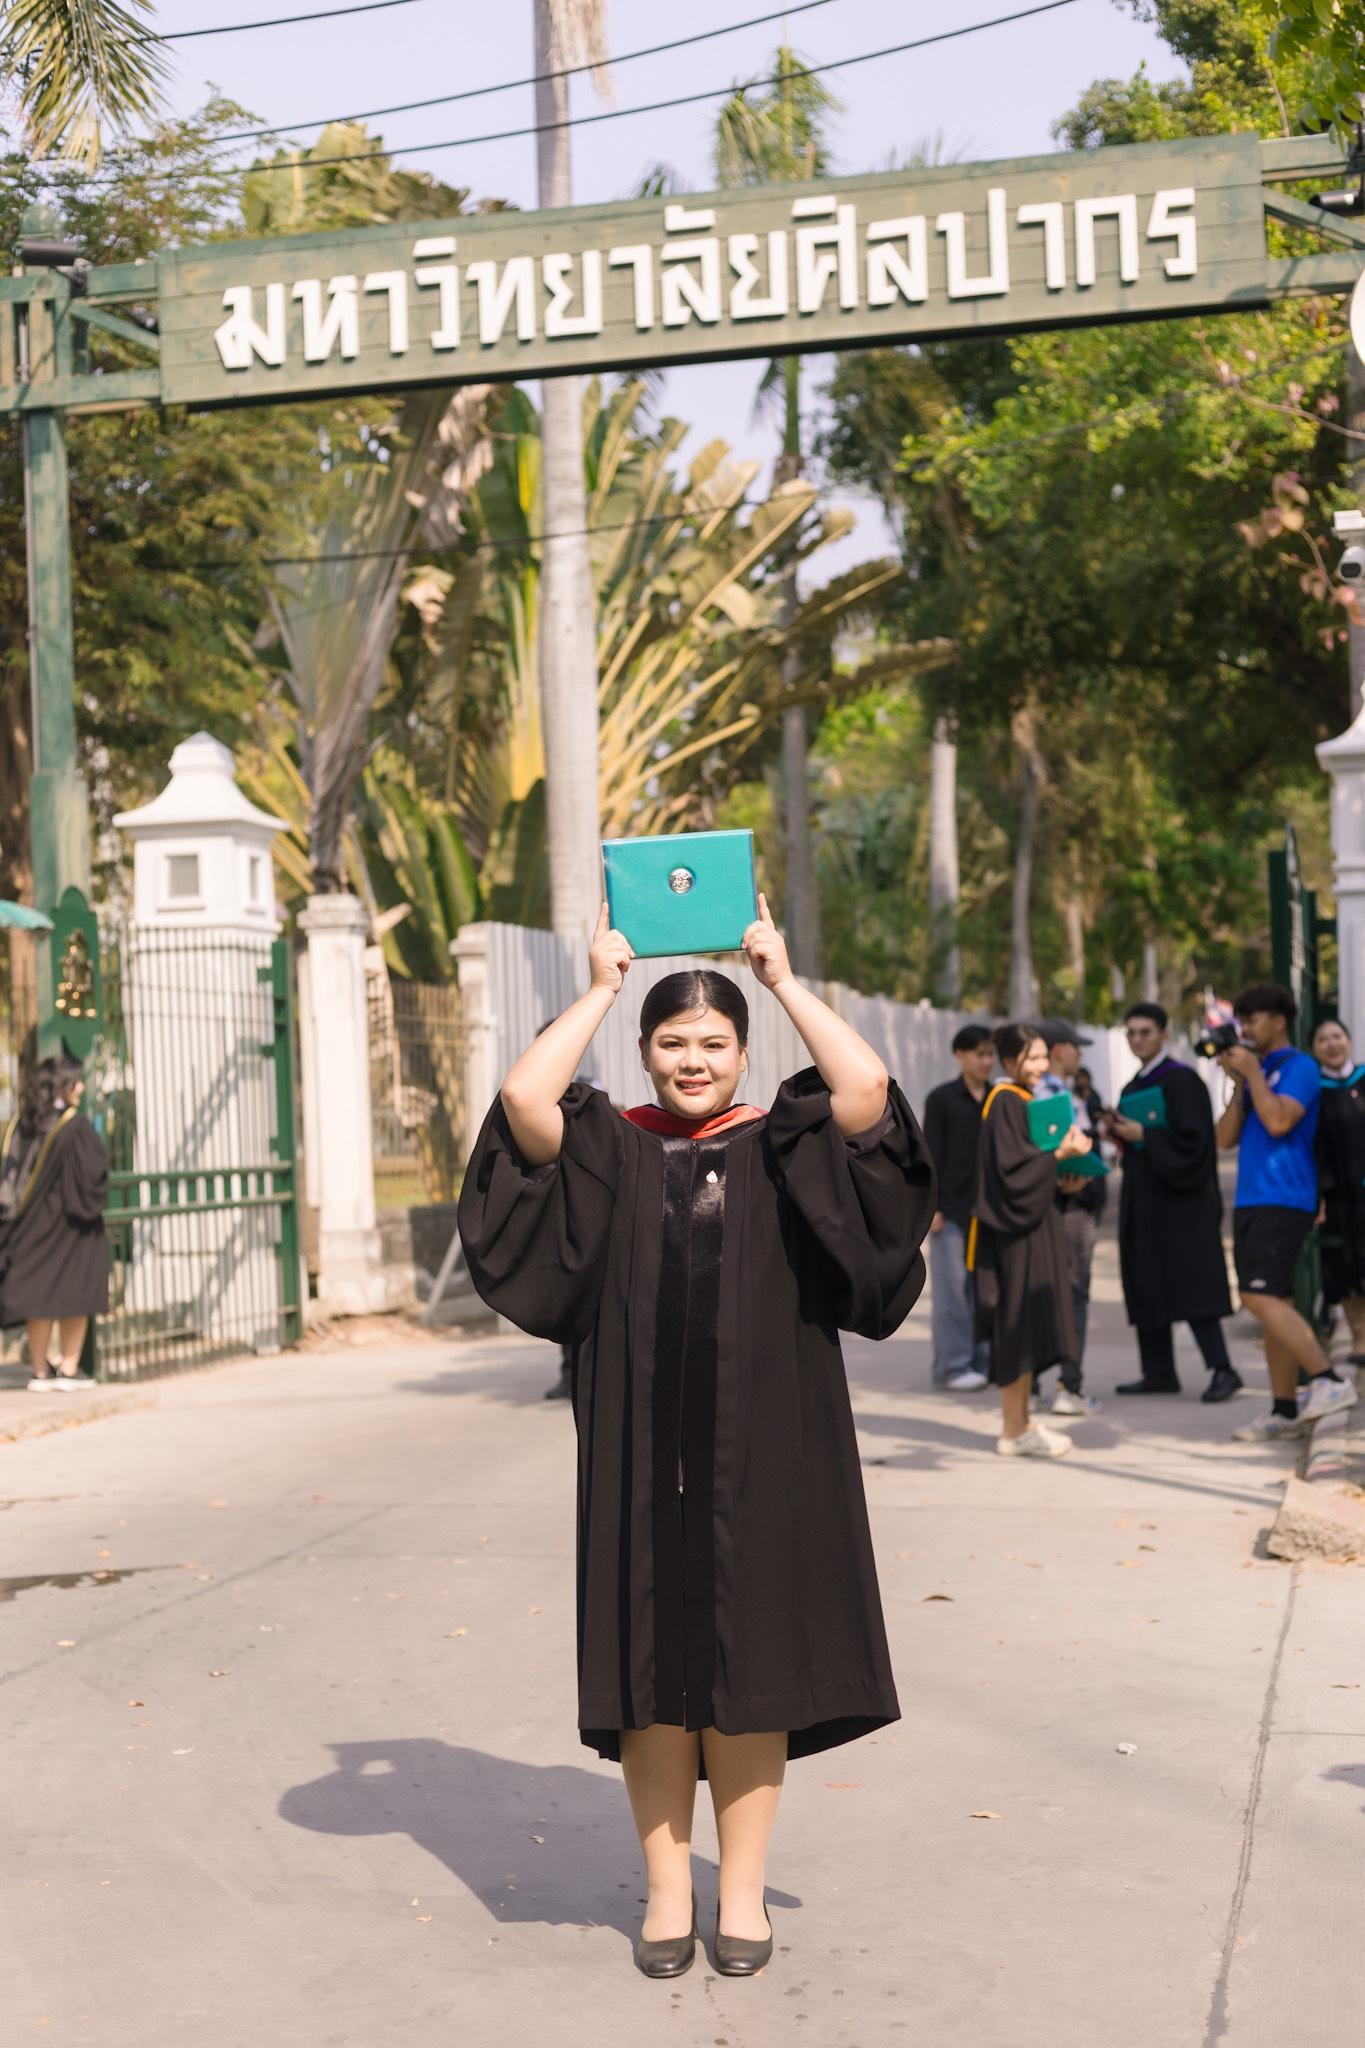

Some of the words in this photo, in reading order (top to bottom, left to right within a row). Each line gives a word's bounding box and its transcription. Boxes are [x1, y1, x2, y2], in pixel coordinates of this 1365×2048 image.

[214, 188, 1198, 369] มหาวิทยาลัยศิลปากร
